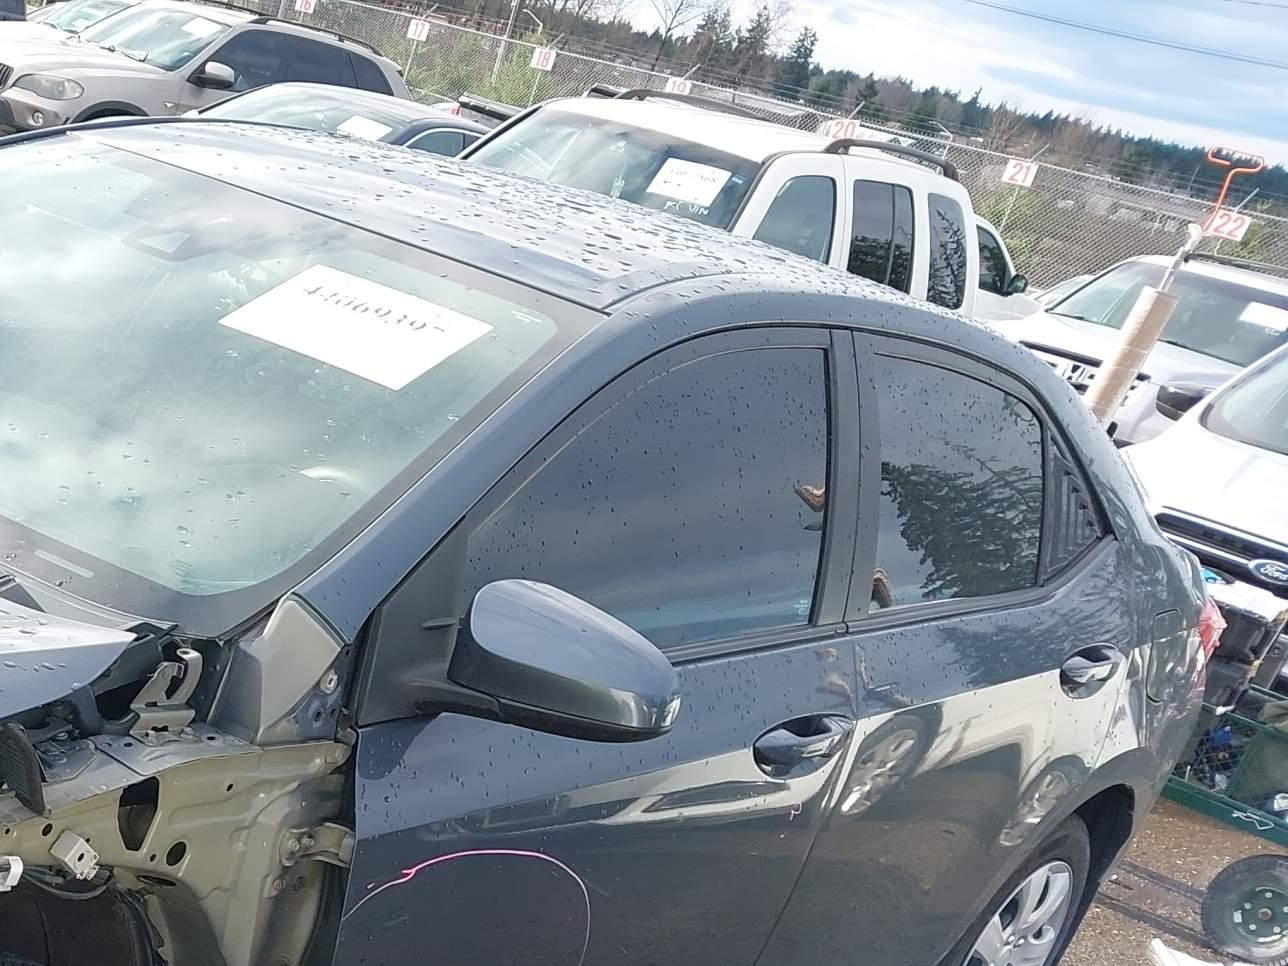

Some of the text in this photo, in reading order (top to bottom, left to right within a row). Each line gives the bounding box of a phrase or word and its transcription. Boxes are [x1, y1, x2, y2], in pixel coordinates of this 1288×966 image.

[414, 22, 426, 39] 17
[537, 50, 552, 68] 18
[832, 121, 856, 139] 20
[1008, 162, 1032, 183] 21
[1213, 213, 1246, 238] 22
